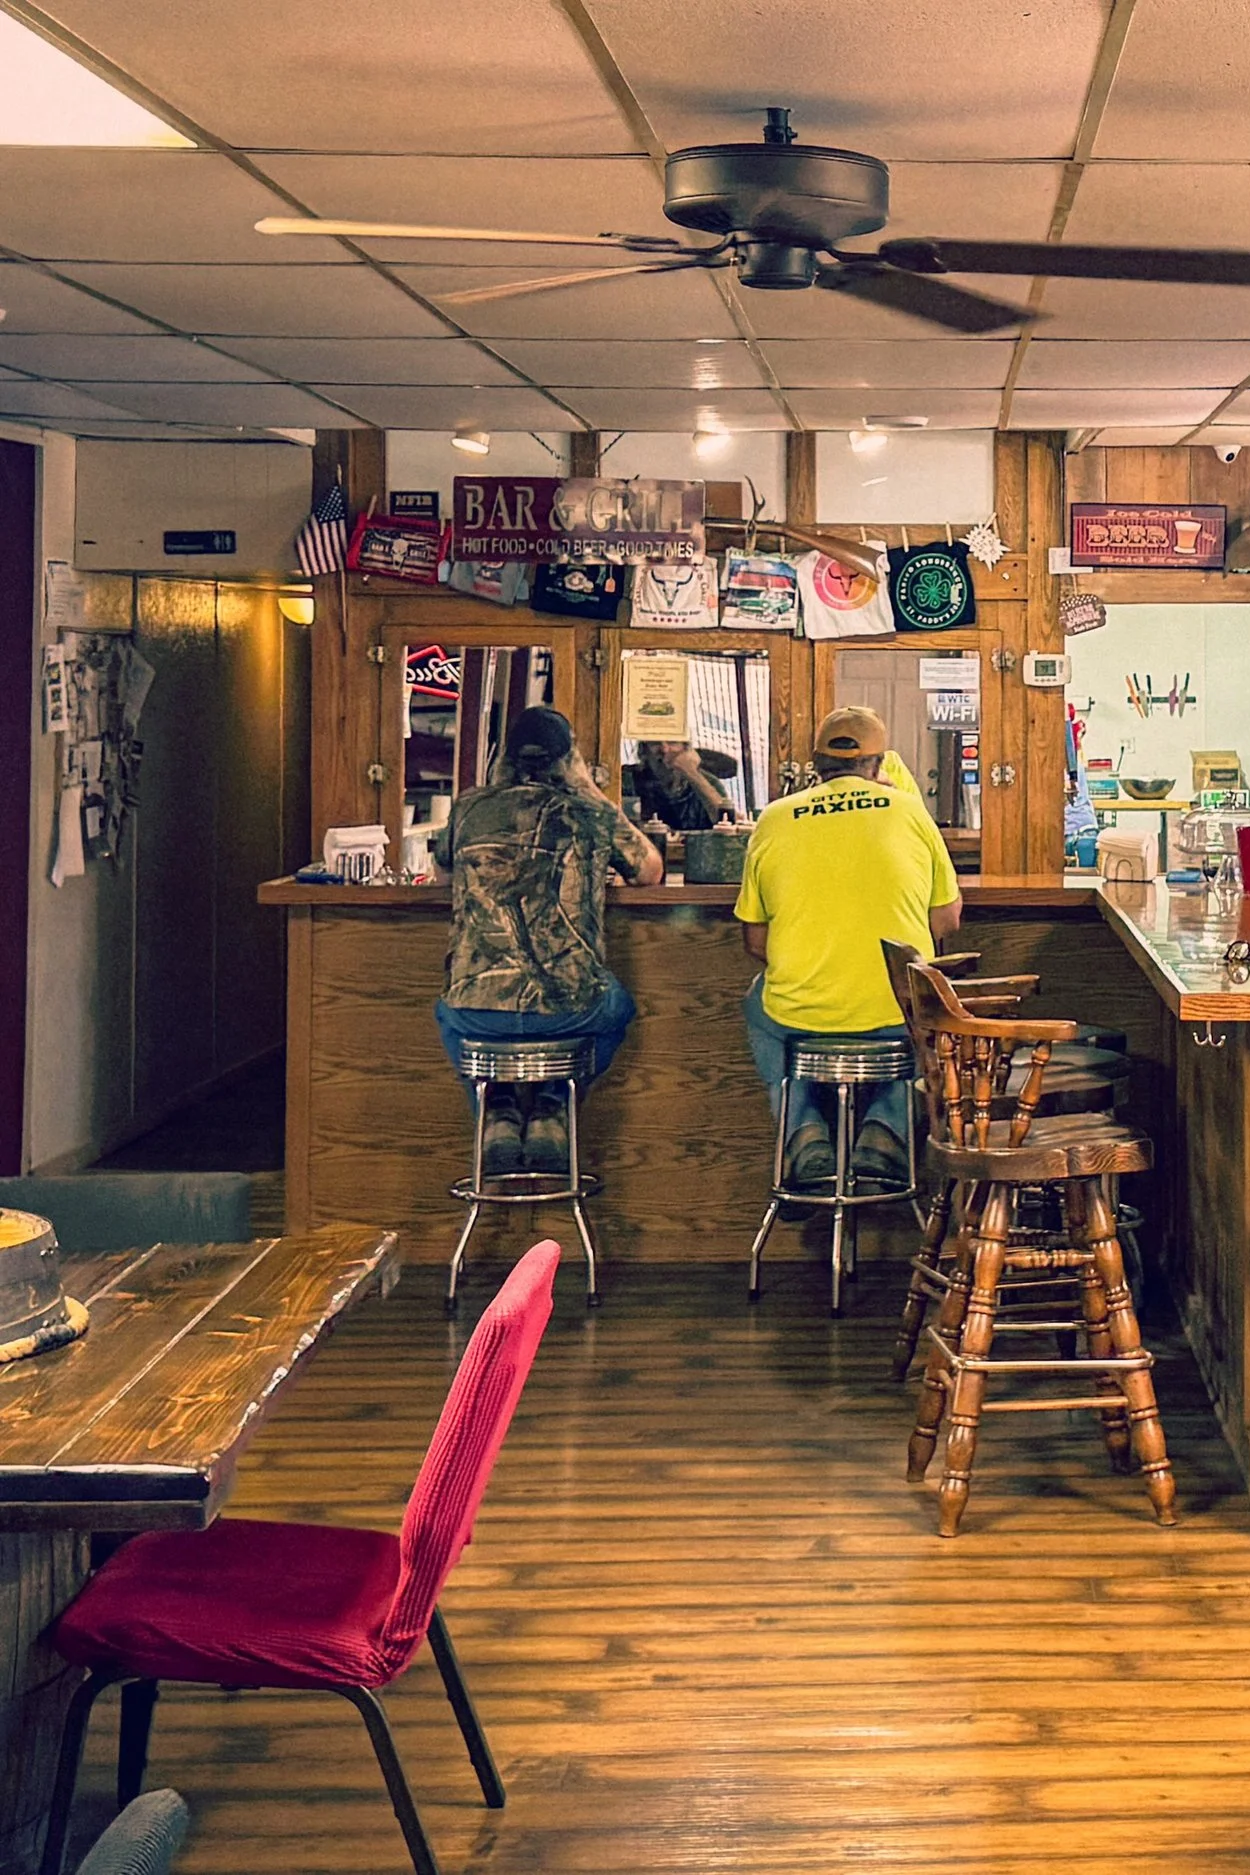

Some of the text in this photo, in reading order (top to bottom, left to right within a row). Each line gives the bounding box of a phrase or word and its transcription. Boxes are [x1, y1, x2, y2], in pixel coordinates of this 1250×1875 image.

[463, 485, 693, 533] BAR & GRILL
[1086, 524, 1170, 548] BEER
[463, 537, 694, 558] HOT FOOD COLD BEER GOOD TIMES
[932, 705, 976, 722] Wi-Fi
[793, 797, 890, 819] PAXICO
[811, 792, 847, 803] CITY
